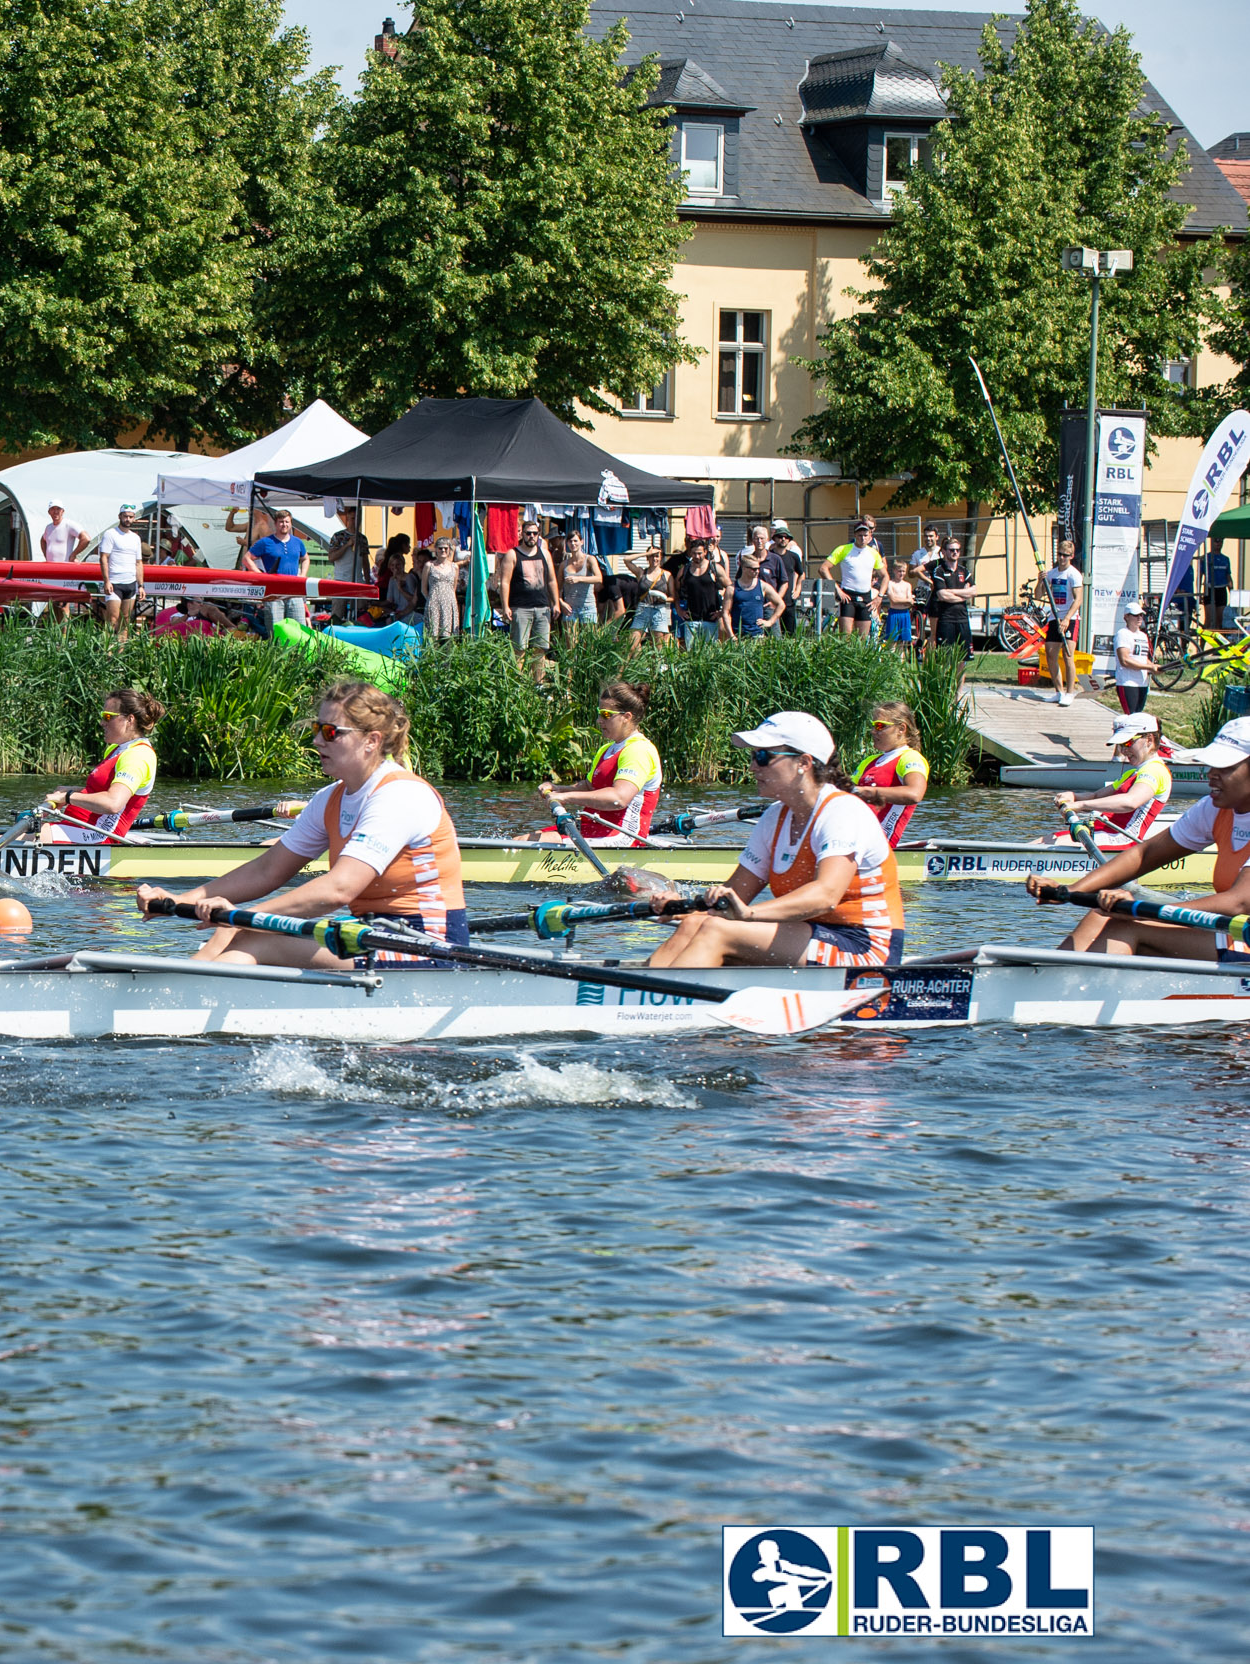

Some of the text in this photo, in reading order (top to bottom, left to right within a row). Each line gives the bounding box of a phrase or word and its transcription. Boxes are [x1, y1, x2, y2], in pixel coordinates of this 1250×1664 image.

[1205, 429, 1245, 488] RBL
[1106, 467, 1134, 480] RBL
[1098, 498, 1123, 506] STARK.
[1098, 506, 1130, 514] SCHNELL.
[1097, 513, 1115, 521] GUT.
[368, 836, 390, 854] Flow
[947, 855, 987, 872] RBL
[992, 859, 1100, 872] RUDER-BUNDESLI
[892, 979, 971, 994] RUHR-ACHTER
[616, 1011, 693, 1024] FlowWaterjet.com
